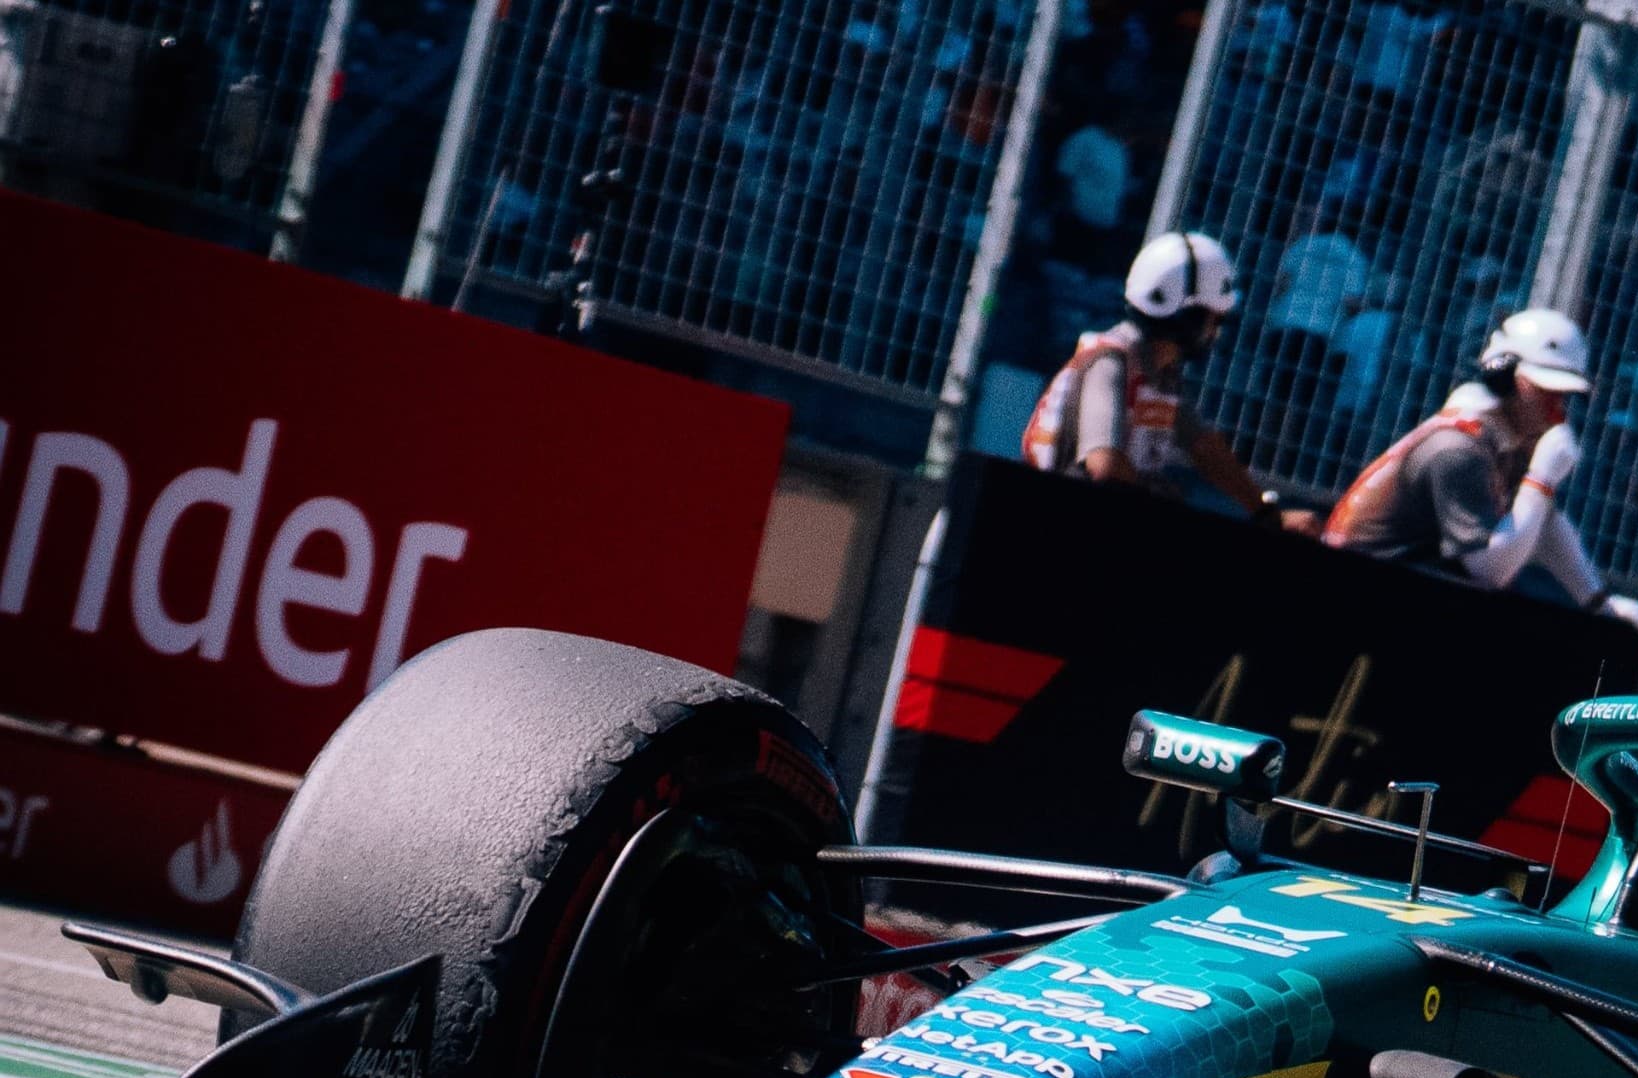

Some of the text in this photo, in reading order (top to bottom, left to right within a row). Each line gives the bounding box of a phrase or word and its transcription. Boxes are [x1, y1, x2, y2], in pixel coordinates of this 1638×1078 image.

[0, 418, 469, 697] nder
[1152, 730, 1237, 775] BOSS
[1268, 875, 1477, 927] 14
[932, 1003, 1117, 1062] xerox
